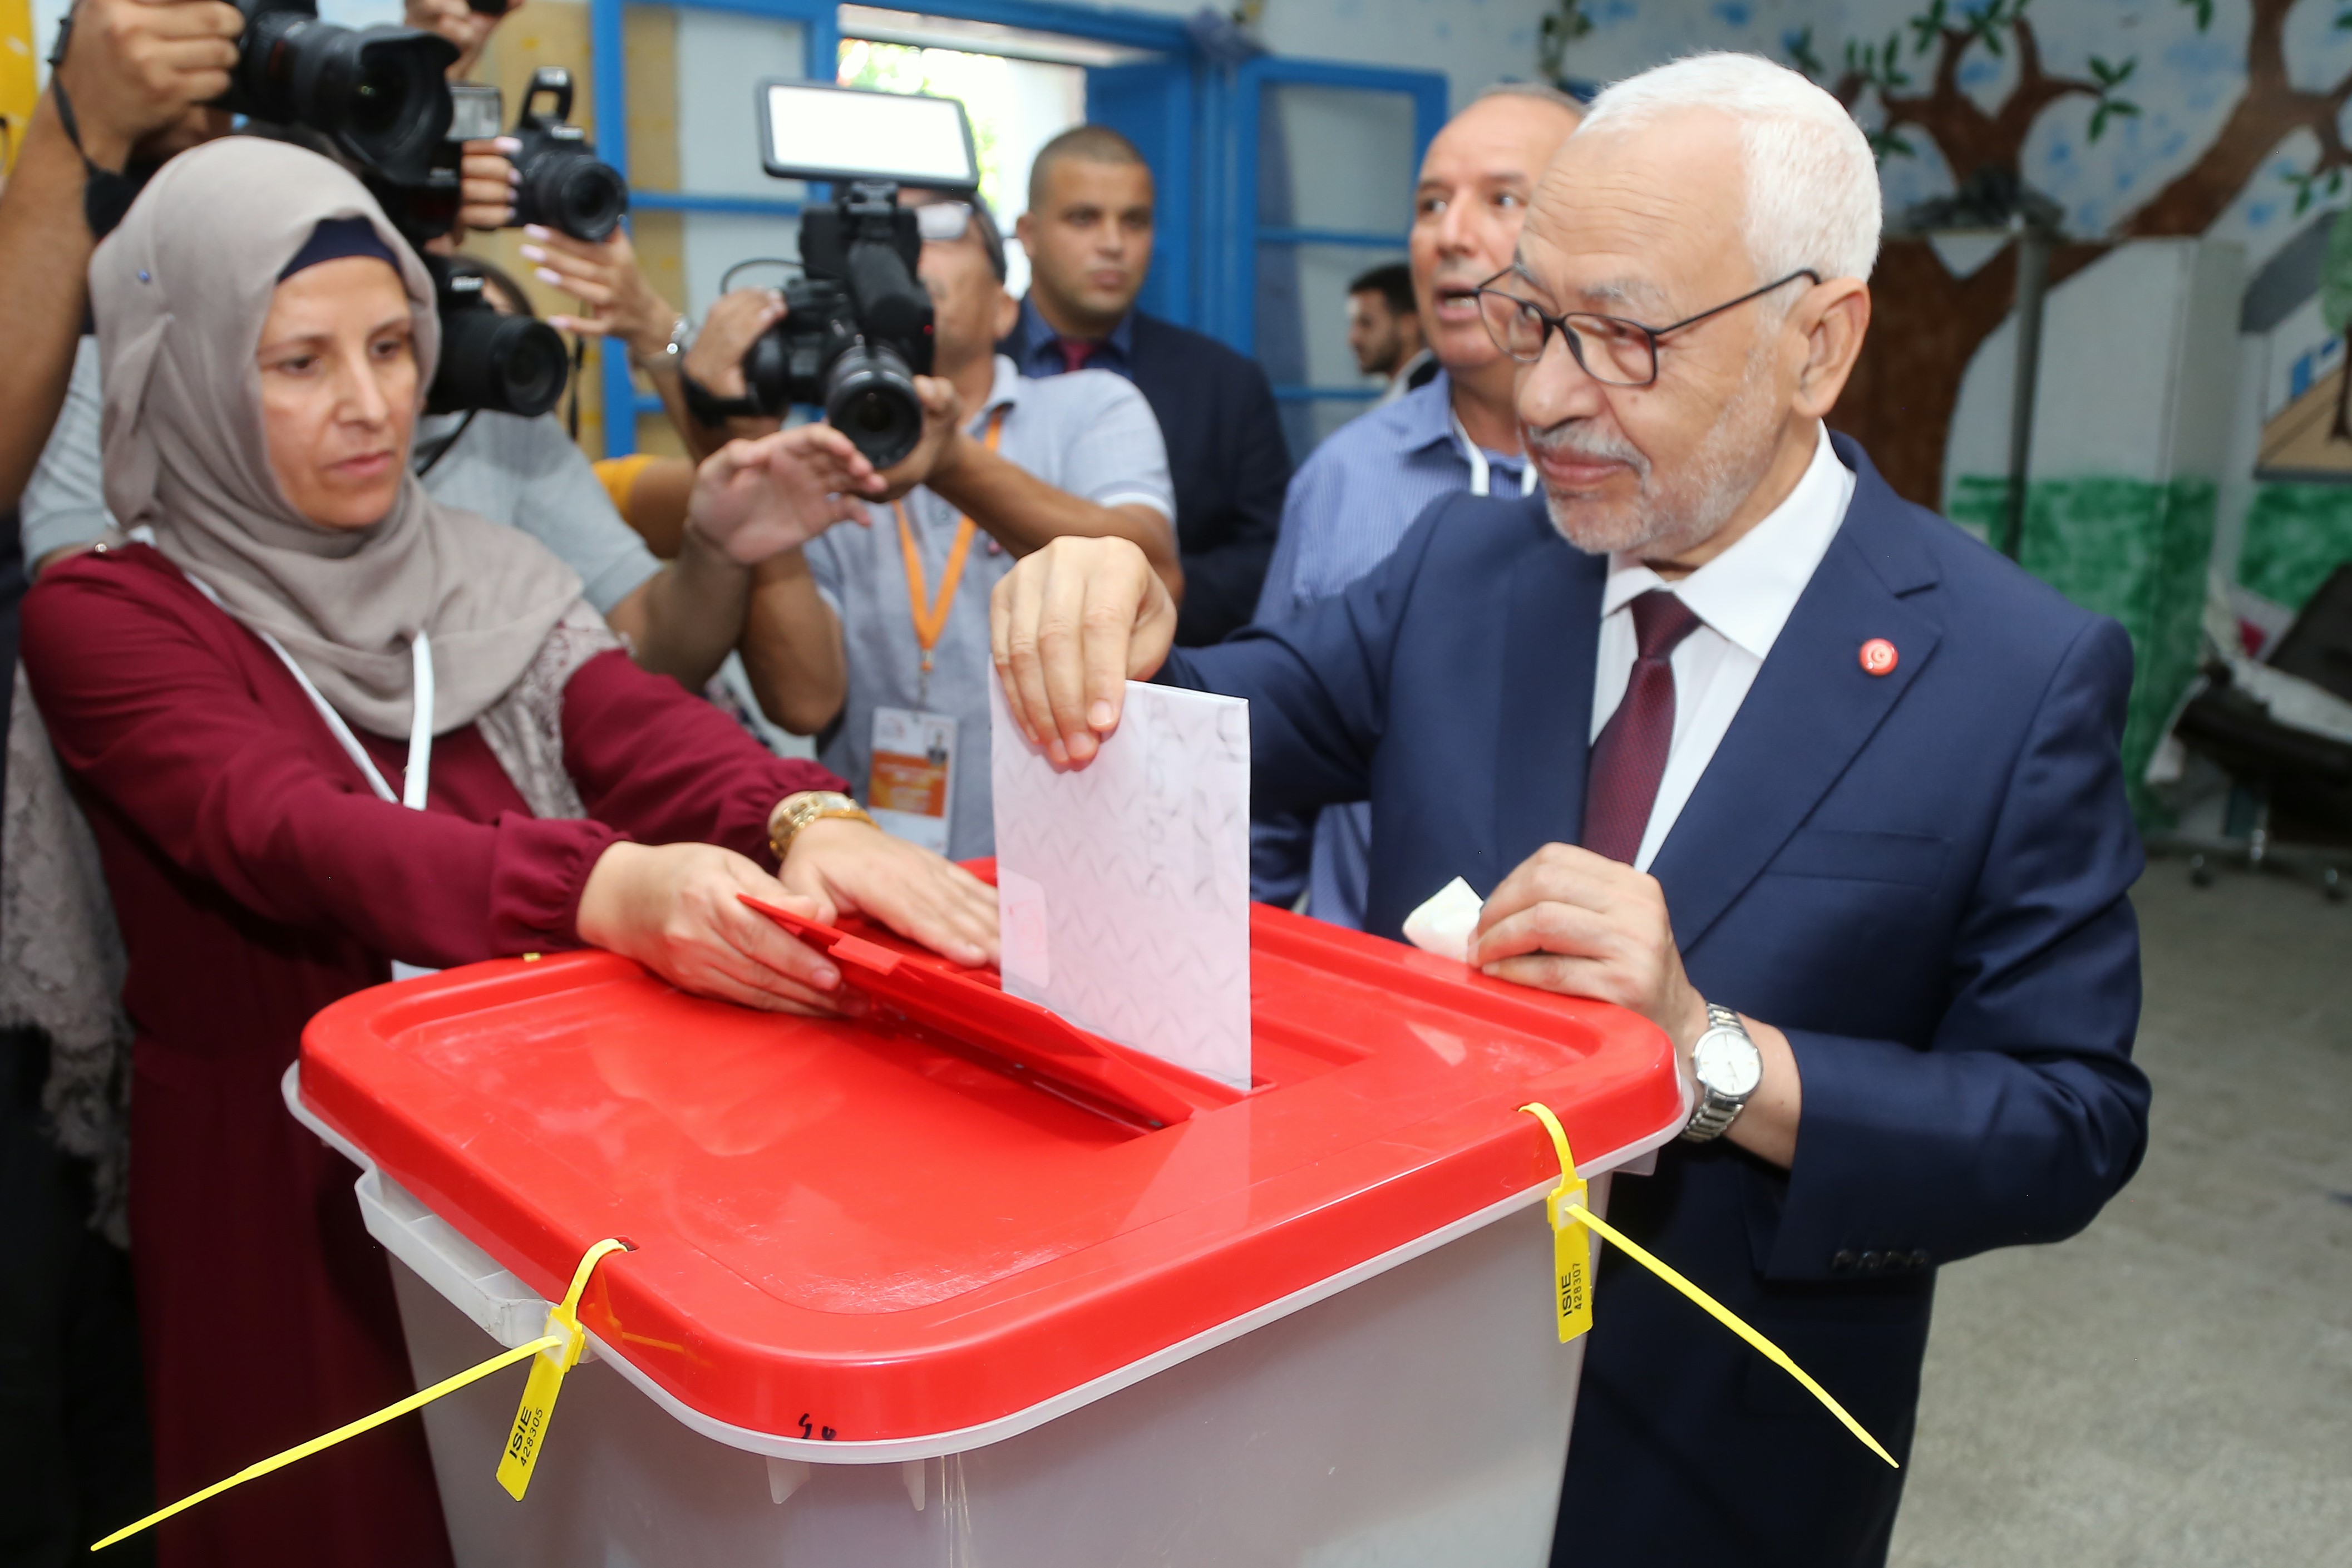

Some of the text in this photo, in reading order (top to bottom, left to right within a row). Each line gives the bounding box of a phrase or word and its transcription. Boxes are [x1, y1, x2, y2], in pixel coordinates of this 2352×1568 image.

[1561, 1272, 1573, 1318] ISIE
[1572, 1263, 1581, 1310] 428307
[509, 1406, 532, 1459] ISIE
[520, 1407, 543, 1467] 428305
